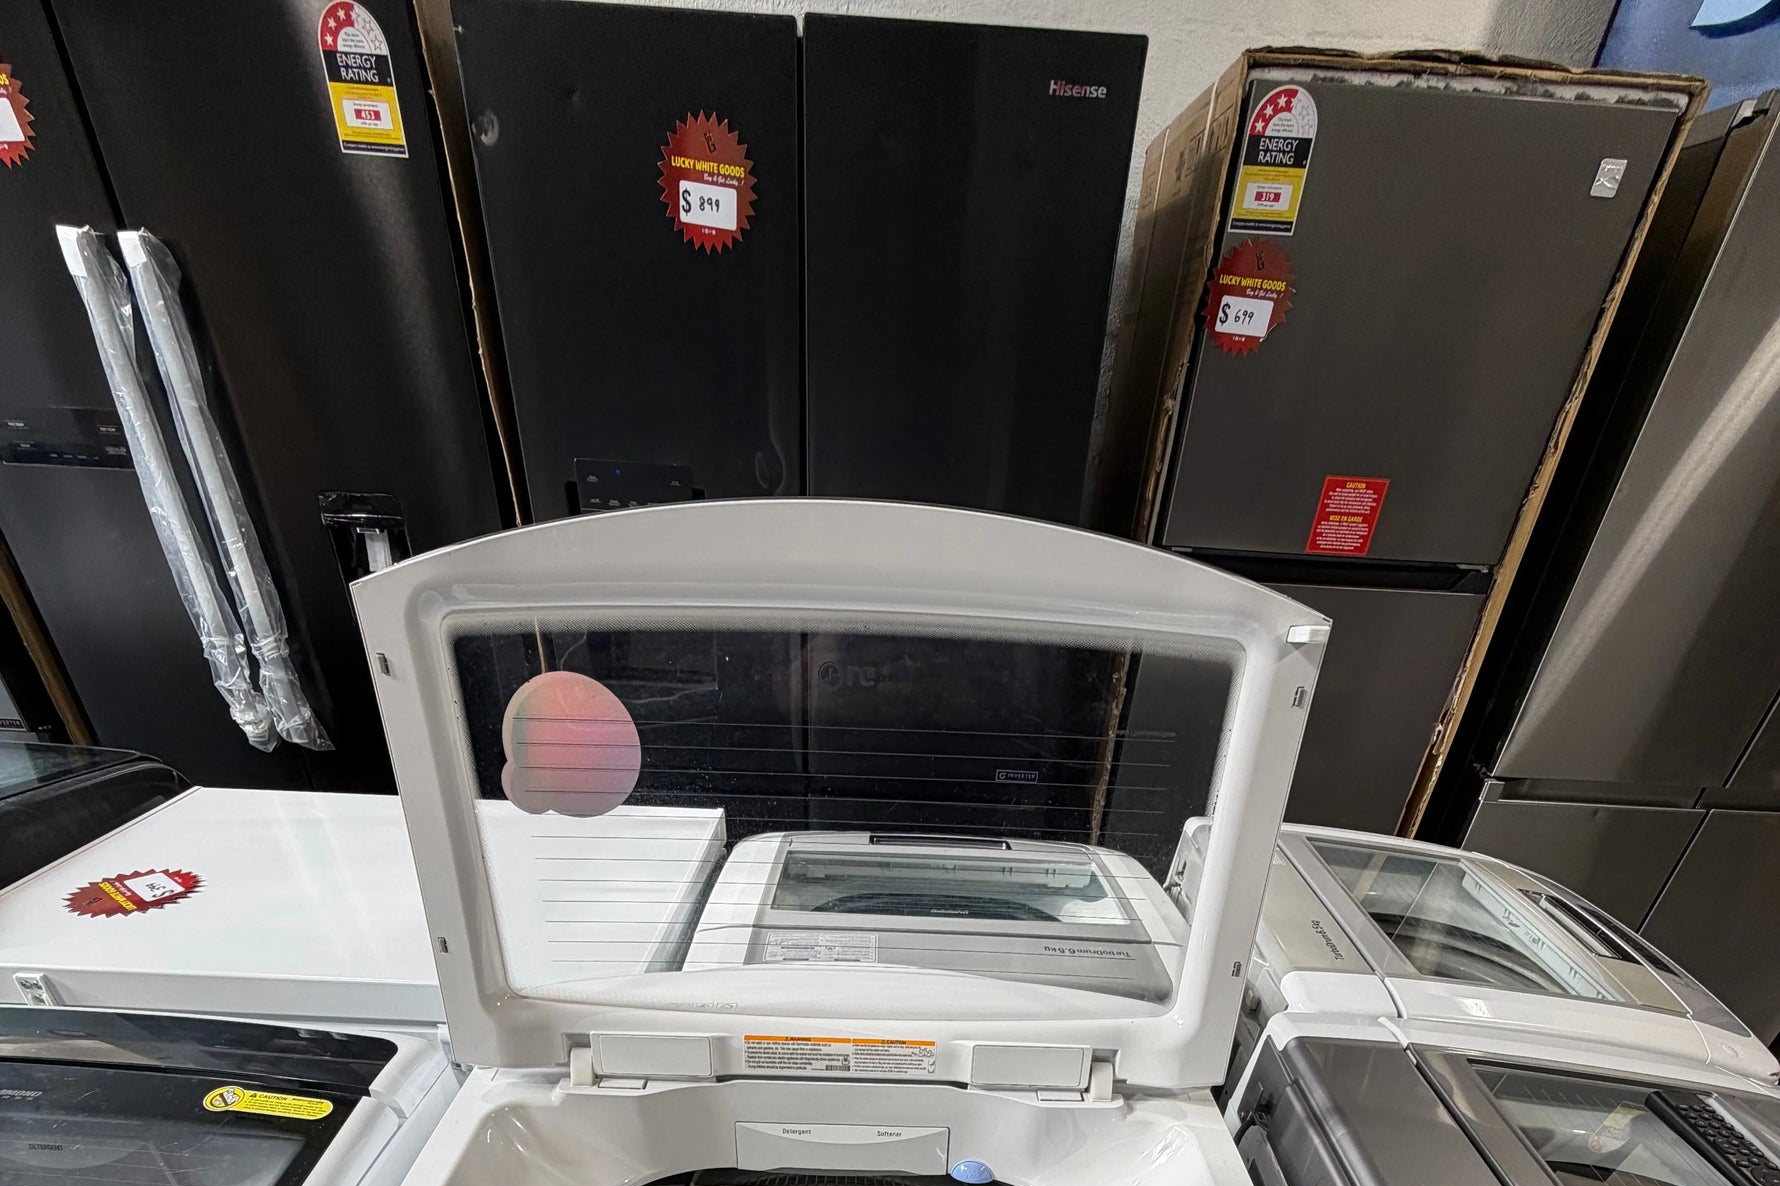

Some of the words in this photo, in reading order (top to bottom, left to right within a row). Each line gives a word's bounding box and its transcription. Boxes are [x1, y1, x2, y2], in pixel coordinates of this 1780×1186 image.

[336, 53, 376, 69] ENERGY
[340, 68, 379, 83] RATING
[1049, 80, 1107, 98] Hisense
[361, 111, 375, 120] 453
[1259, 138, 1299, 152] ENERGY
[1258, 151, 1295, 165] RATING
[671, 155, 695, 170] LUCKY
[695, 160, 718, 173] WHITE
[719, 163, 745, 178] GOODS
[682, 187, 691, 216] $
[699, 196, 720, 213] 899
[1261, 192, 1275, 201] 319
[1219, 274, 1241, 286] LUCKY
[1241, 277, 1262, 288] WHITE
[1262, 280, 1286, 291] GOODS
[1219, 301, 1231, 326] $
[1234, 309, 1254, 325] 699
[782, 1128, 812, 1136] Detergent
